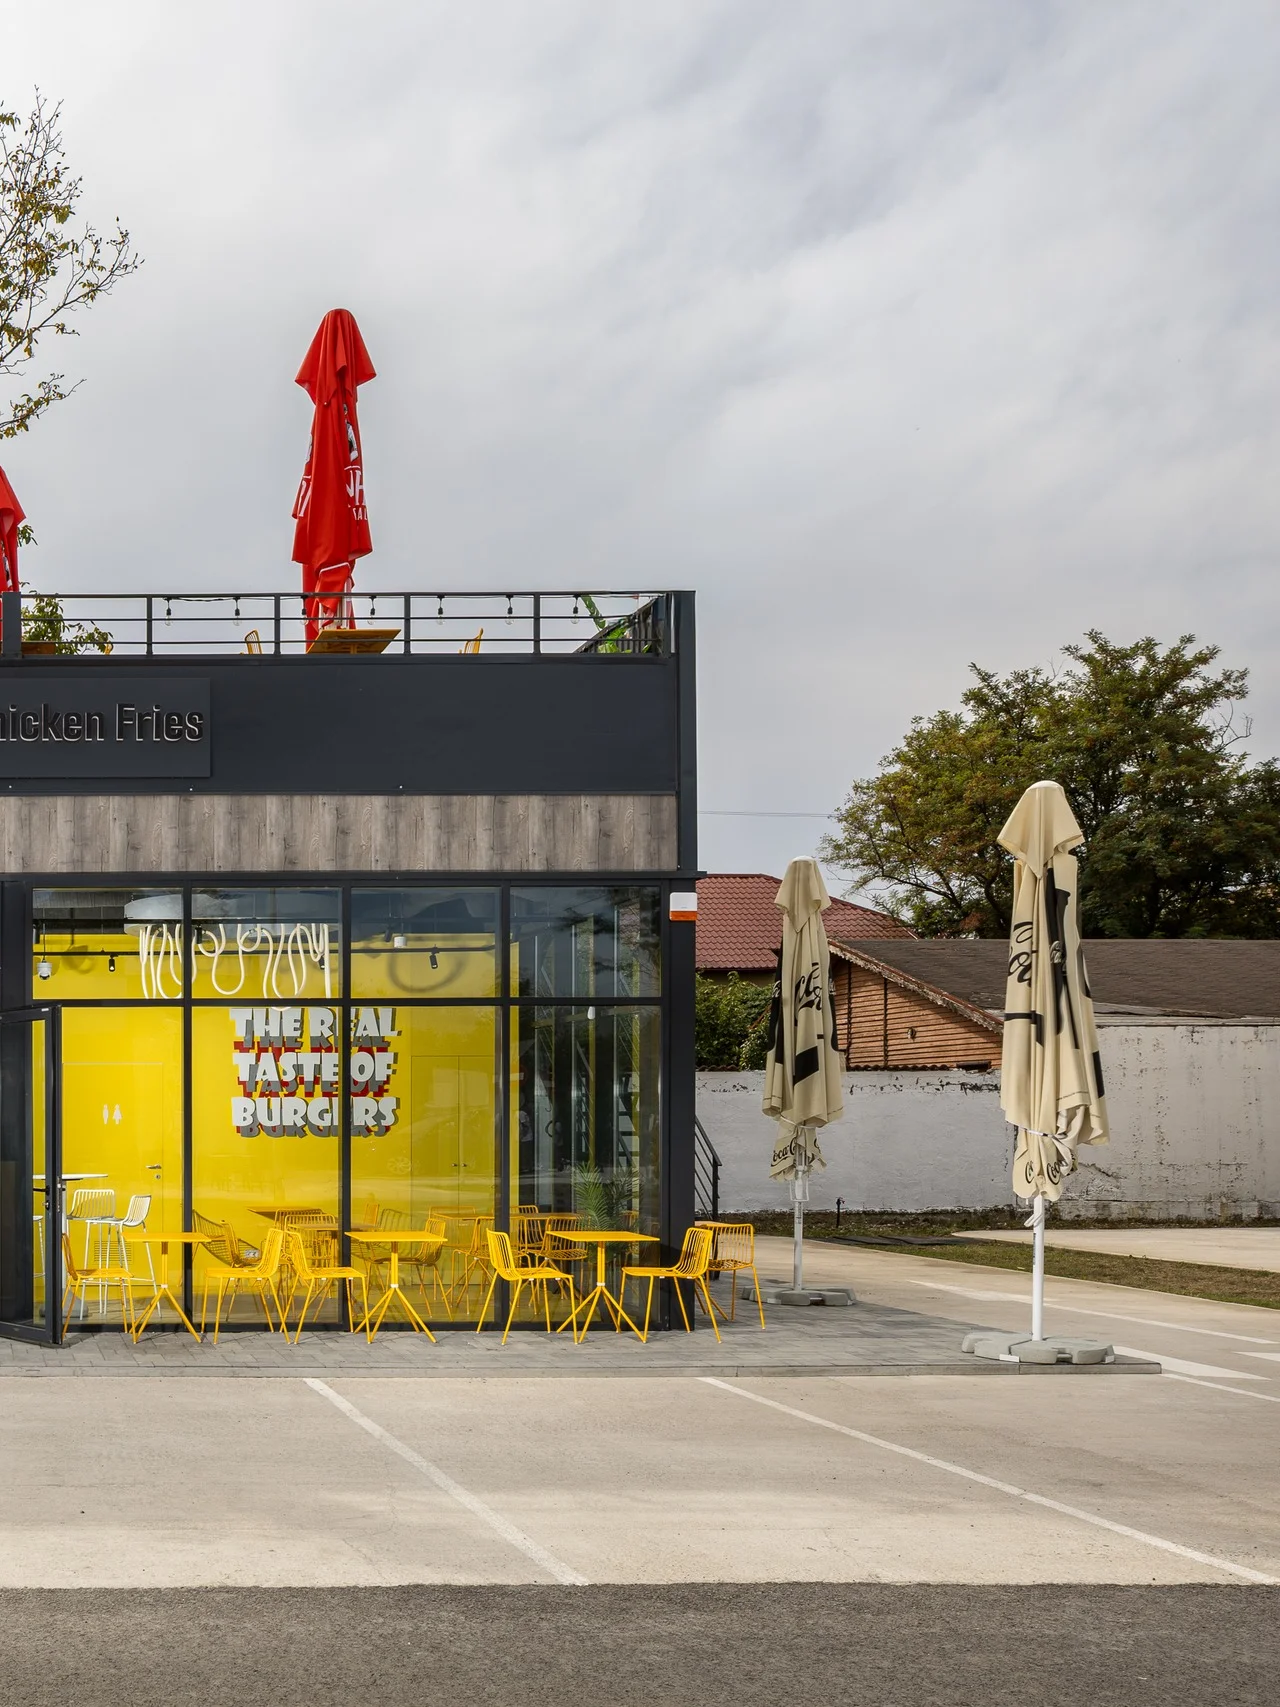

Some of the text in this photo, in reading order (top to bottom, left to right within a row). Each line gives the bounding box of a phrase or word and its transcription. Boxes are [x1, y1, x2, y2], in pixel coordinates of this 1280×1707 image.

[115, 703, 204, 742] Fries
[229, 1007, 303, 1040] THE
[232, 1051, 397, 1085] TASTE OF
